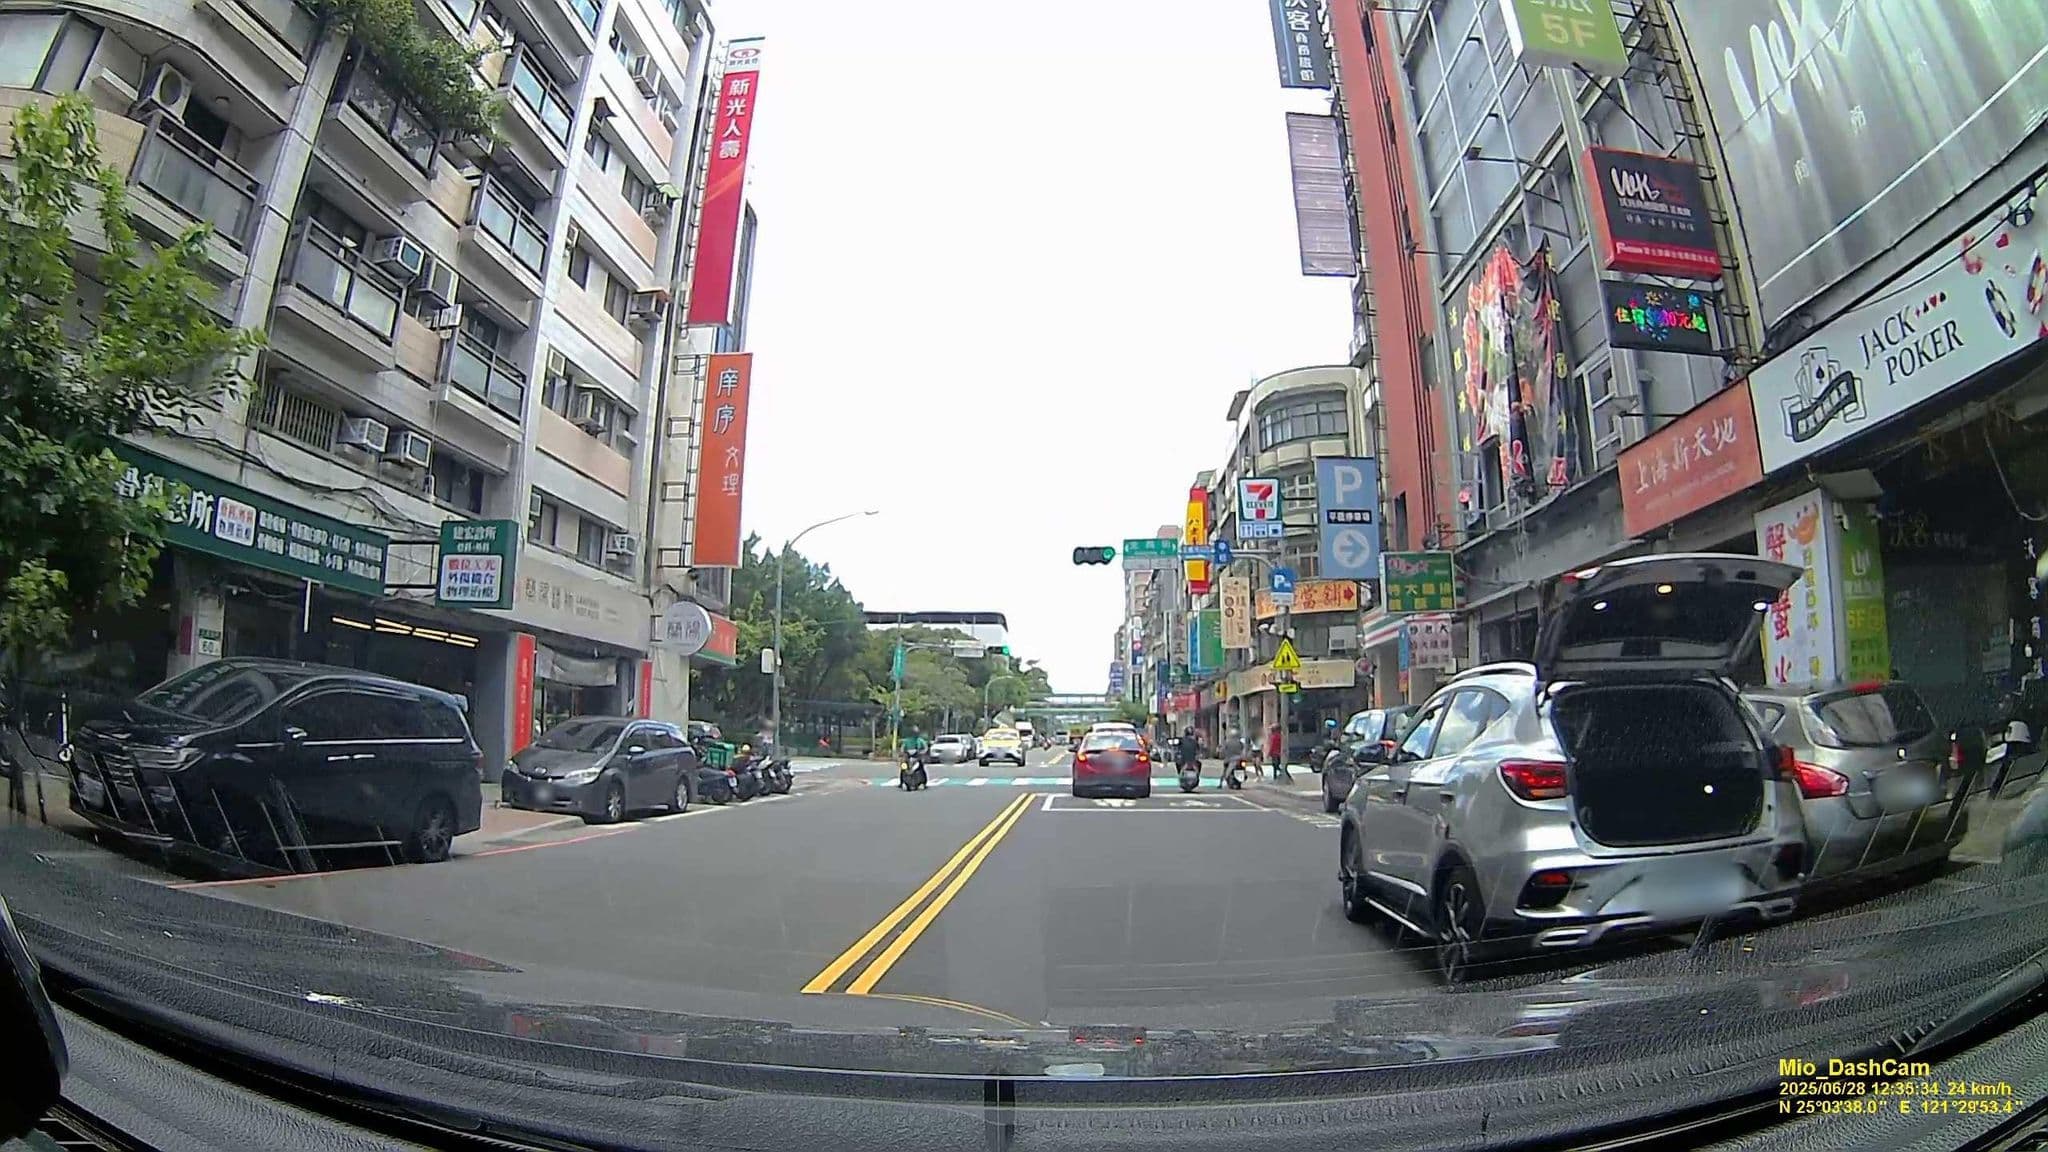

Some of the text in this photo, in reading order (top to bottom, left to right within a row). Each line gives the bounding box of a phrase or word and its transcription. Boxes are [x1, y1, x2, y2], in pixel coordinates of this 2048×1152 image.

[1541, 14, 1595, 48] 5F
[719, 78, 750, 159] 新光人壽
[1859, 305, 1917, 369] JACK
[1884, 320, 1964, 386] POKER
[722, 446, 739, 496] 文理
[1334, 466, 1362, 503] P
[1274, 574, 1285, 588] P
